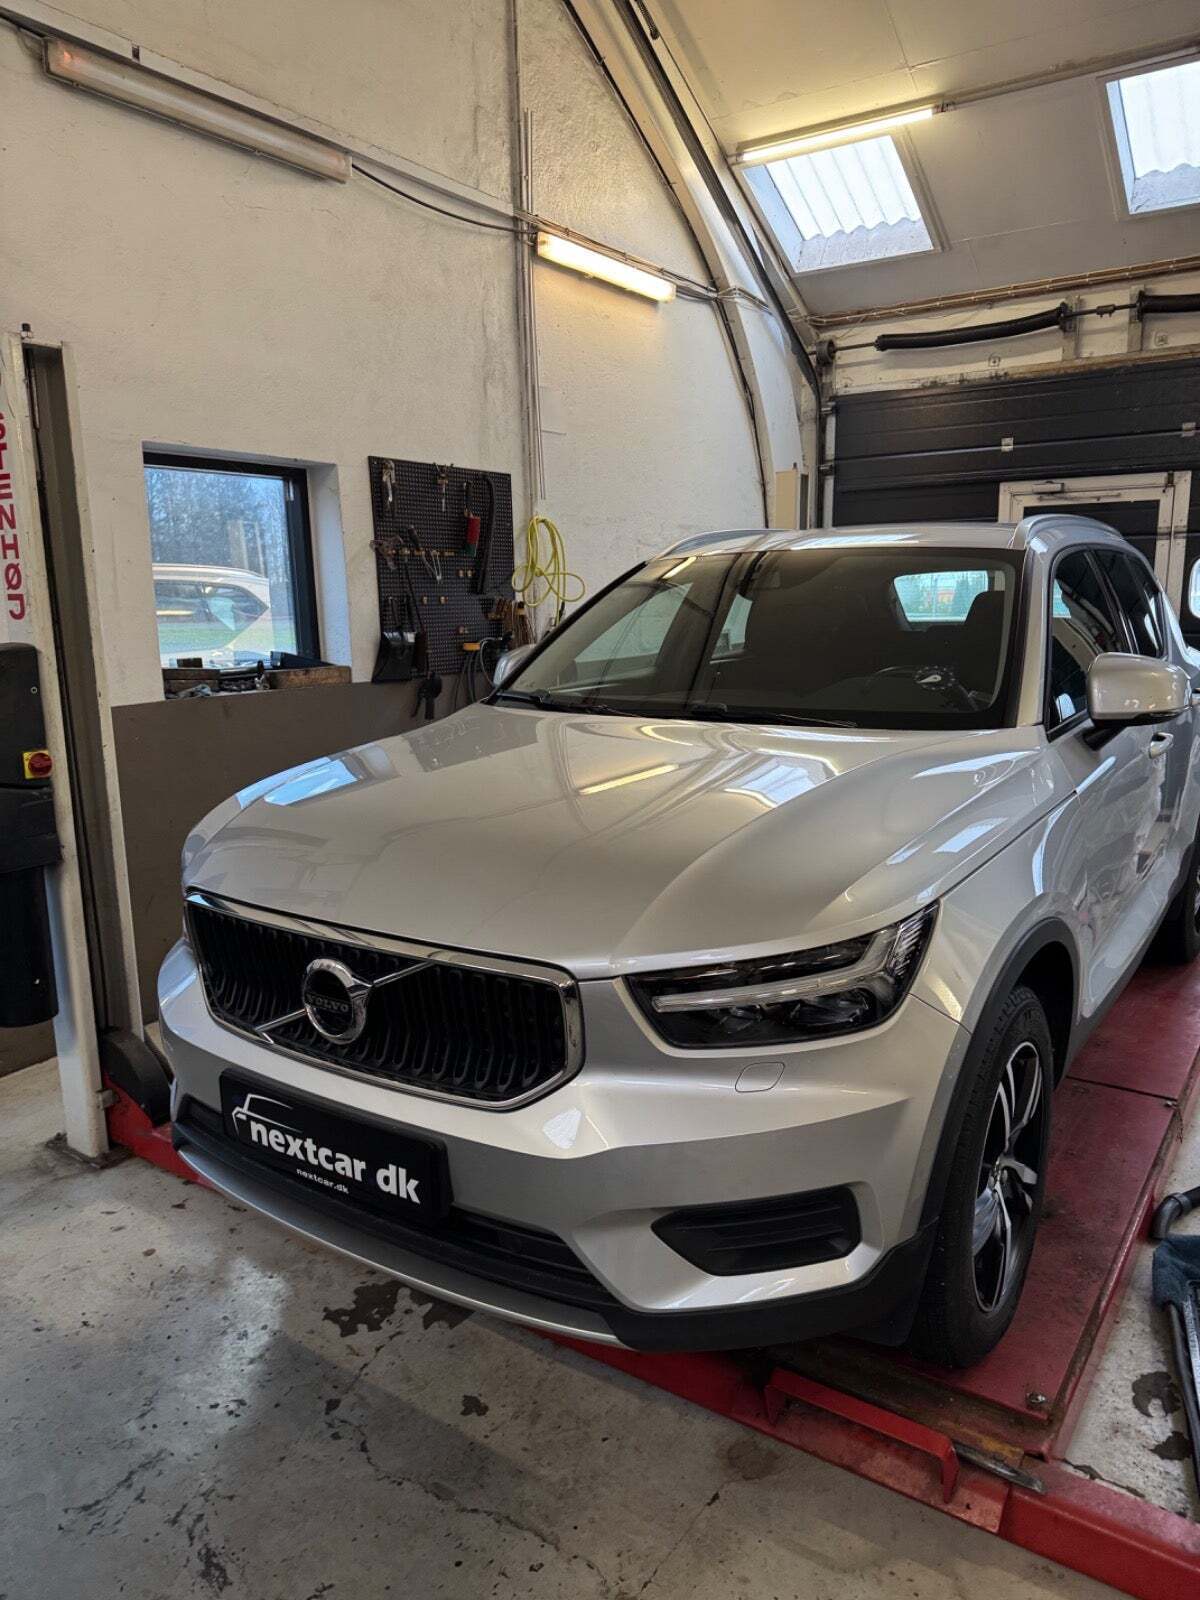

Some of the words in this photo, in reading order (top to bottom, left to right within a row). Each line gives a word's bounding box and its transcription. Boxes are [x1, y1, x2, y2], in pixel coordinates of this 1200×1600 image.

[305, 993, 349, 1013] VOLVO
[250, 1119, 366, 1182] nextcar
[376, 1163, 420, 1204] dk
[297, 1168, 349, 1194] nextcar.dk
